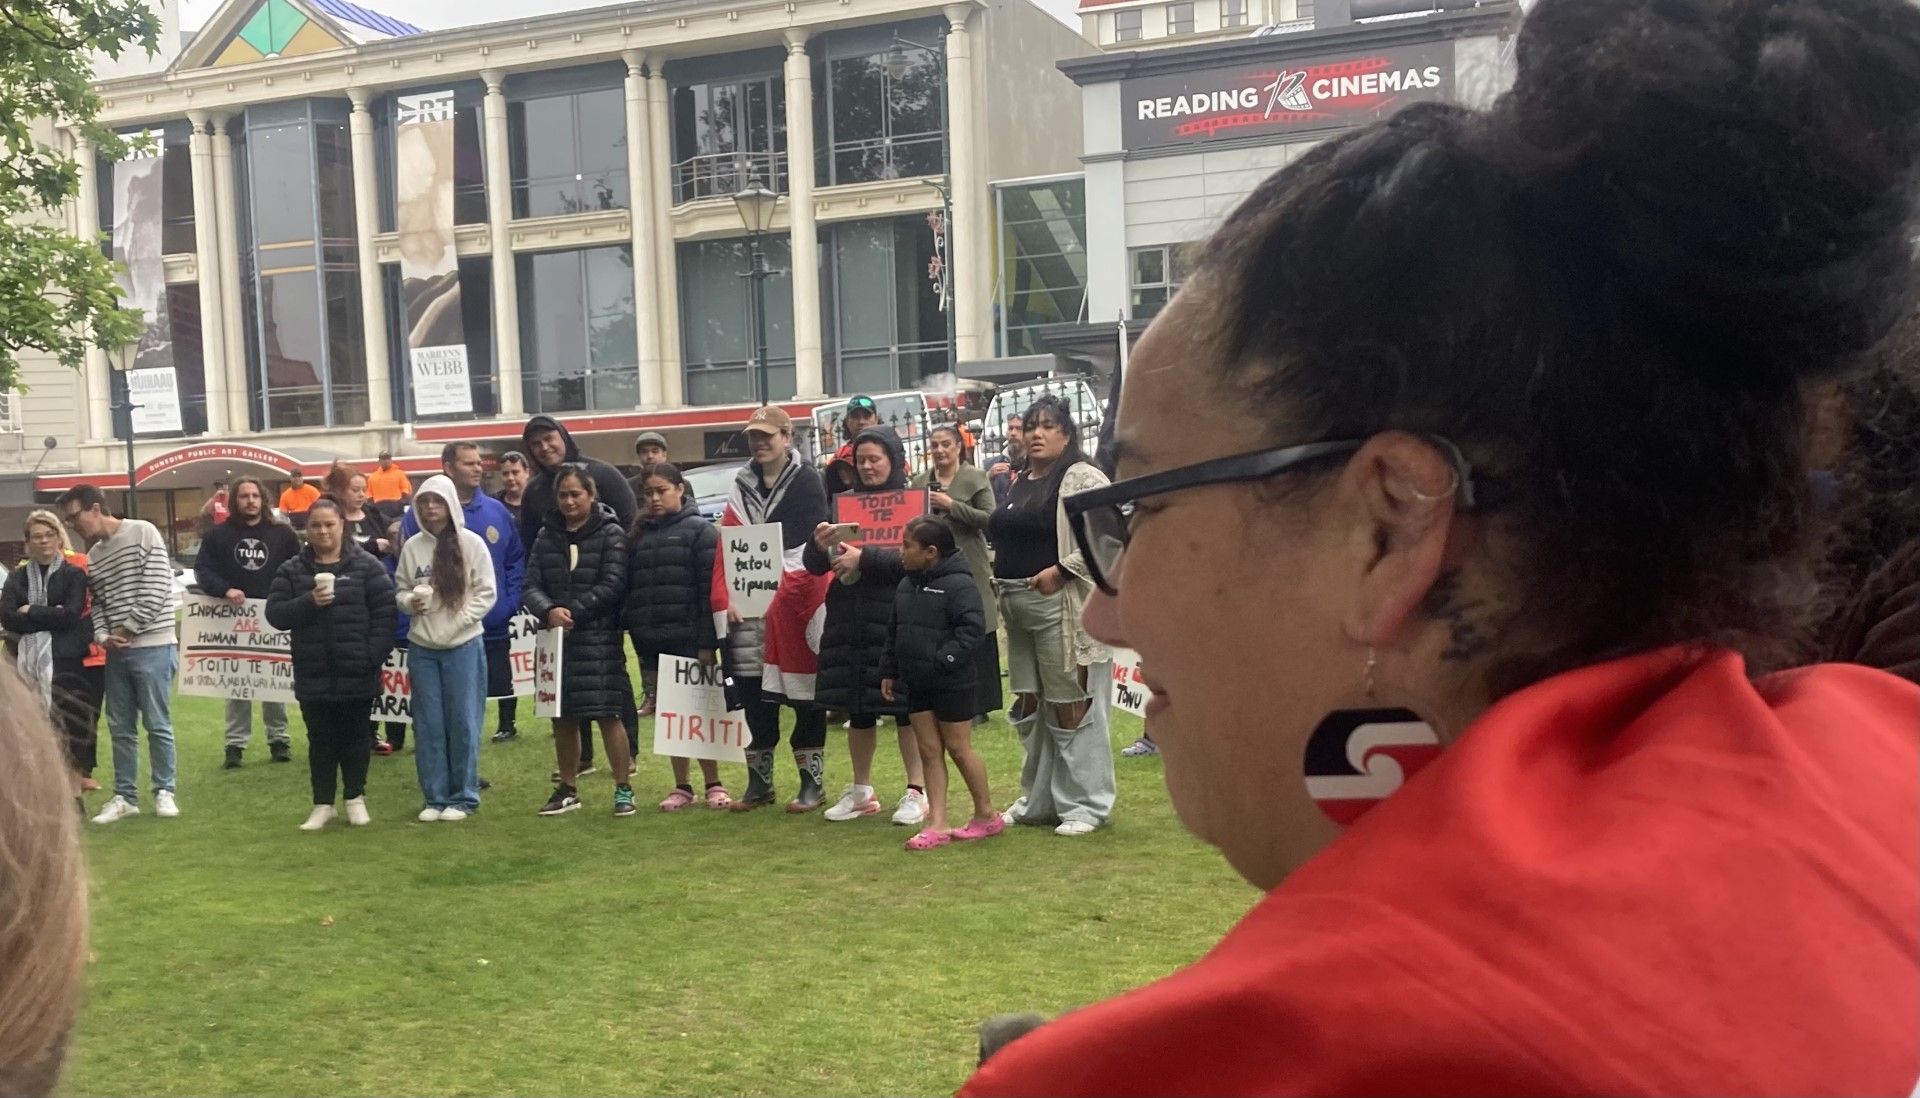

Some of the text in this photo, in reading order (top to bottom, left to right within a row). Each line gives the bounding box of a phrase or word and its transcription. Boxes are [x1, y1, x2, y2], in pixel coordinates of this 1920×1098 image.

[1138, 87, 1258, 120] READING
[1312, 66, 1440, 99] CINEMAS
[418, 361, 463, 376] WEBB
[149, 455, 184, 472] DUNEDIN
[188, 448, 216, 458] PUBLIC
[242, 451, 279, 464] GALLERY
[868, 508, 894, 522] TE
[238, 548, 265, 559] TUIA
[187, 602, 258, 618] INDIGENOUS
[234, 619, 260, 631] ARE
[198, 632, 292, 646] HUMAN RIGHTS
[247, 660, 262, 674] TE
[231, 688, 255, 698] NEI
[692, 688, 719, 711] TE
[660, 712, 742, 747] TIRITI
